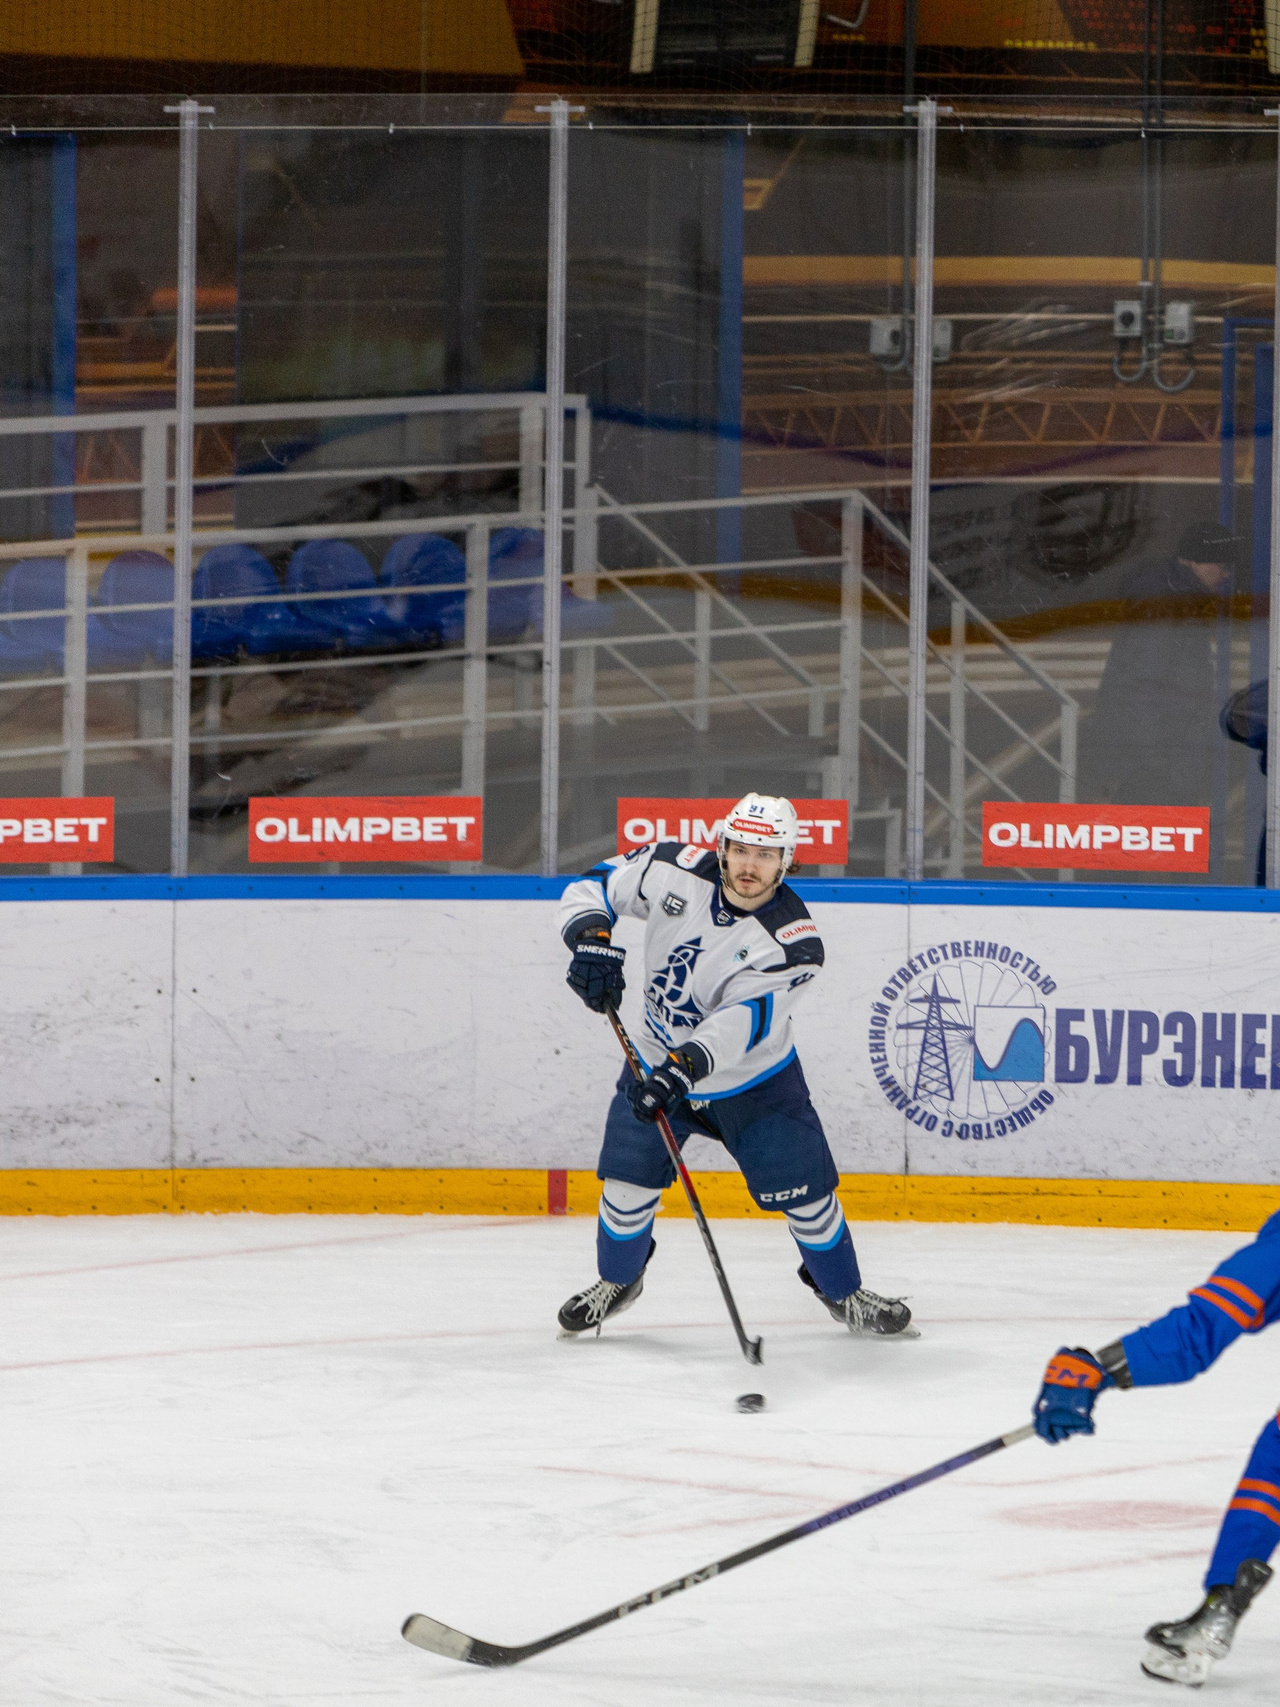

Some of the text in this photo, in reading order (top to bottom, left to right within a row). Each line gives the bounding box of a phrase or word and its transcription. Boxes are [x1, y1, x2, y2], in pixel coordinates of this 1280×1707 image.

[749, 805, 765, 814] 91
[255, 816, 475, 843] OLIMPBET
[623, 817, 841, 845] OLIMET
[734, 820, 773, 833] OLIMPBET
[988, 822, 1203, 853] OLIMPBET
[577, 944, 625, 961] SHERWO
[881, 940, 1058, 1002] ОТВЕТСТВЕННОСТЬЮ
[868, 1001, 940, 1133] ОГРАНИЧЕННОЙ
[959, 1088, 1056, 1141] ОБЩЕСТВО
[759, 1184, 808, 1203] CCM
[618, 1562, 720, 1619] CCM
